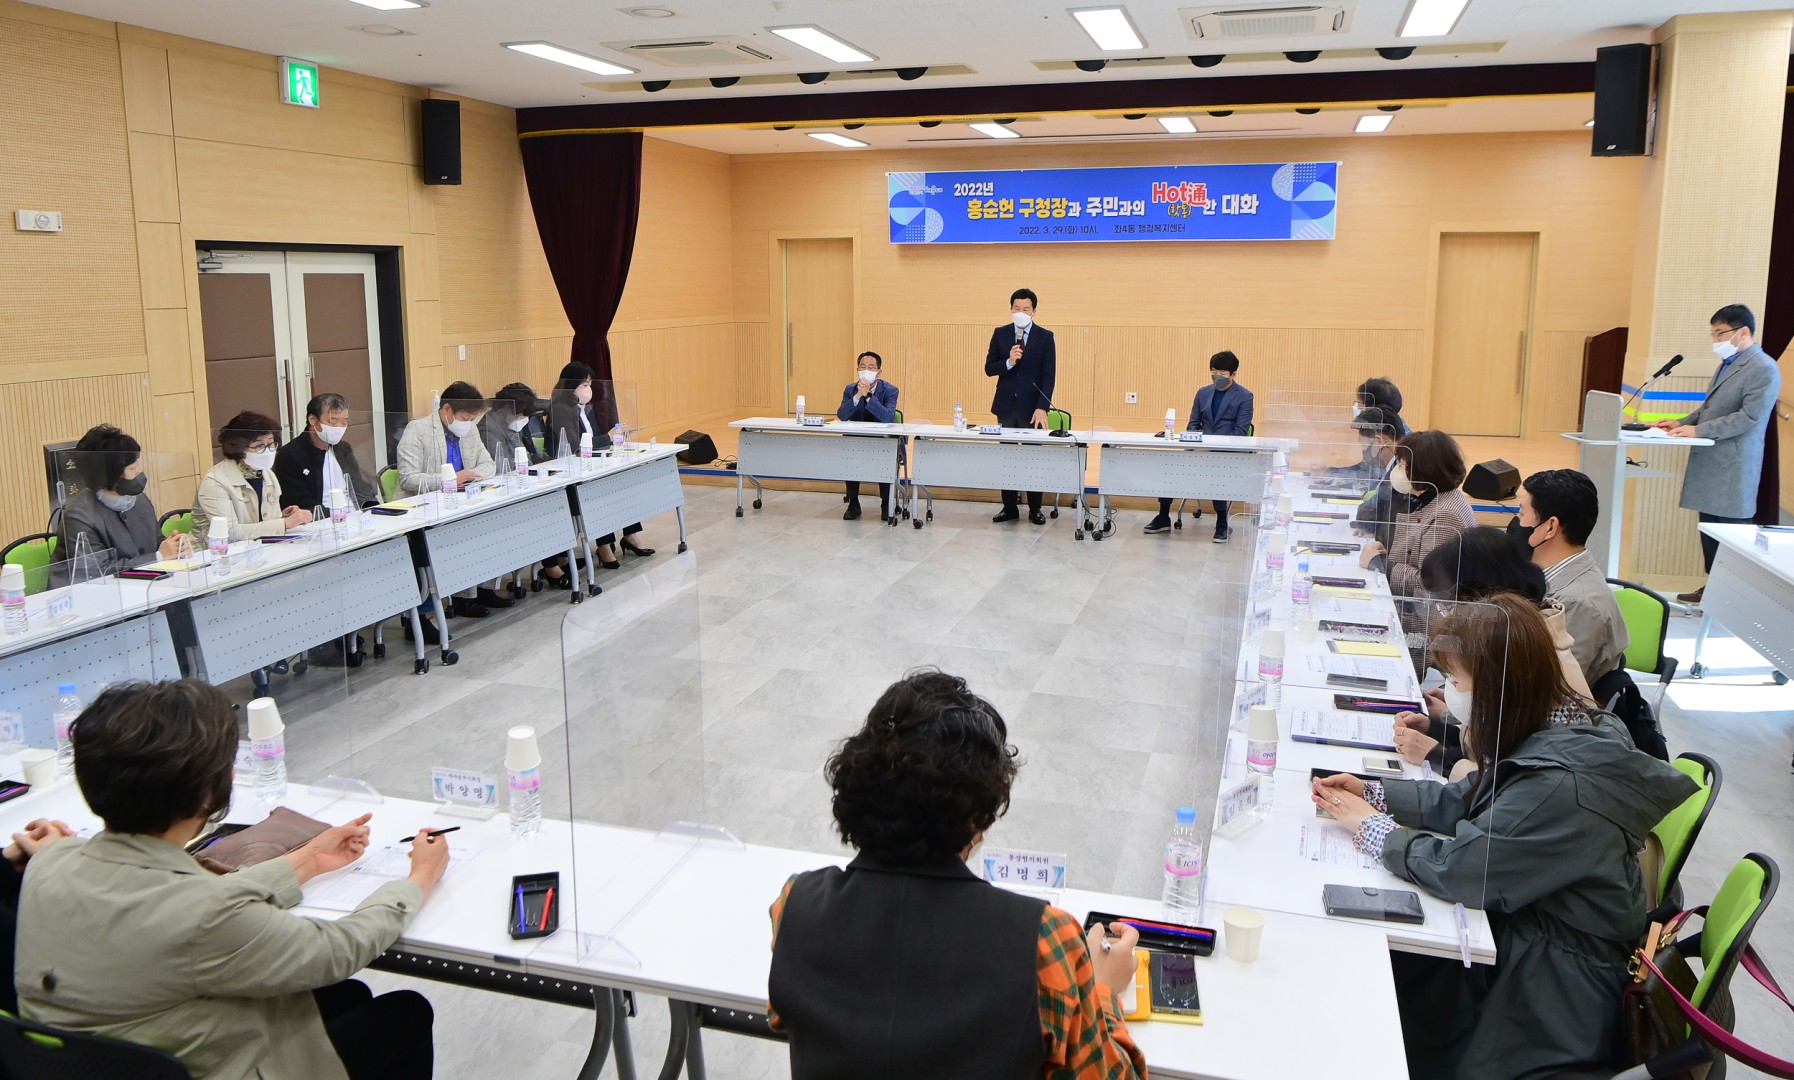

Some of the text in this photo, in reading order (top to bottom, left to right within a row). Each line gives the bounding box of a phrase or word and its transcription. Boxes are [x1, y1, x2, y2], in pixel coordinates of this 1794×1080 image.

[954, 182, 994, 197] 2022년
[967, 198, 1015, 220] 홍순헌
[1018, 197, 1081, 219] 구청장과
[1085, 196, 1146, 217] 주민과의
[1221, 194, 1260, 215] 대화
[1019, 226, 1040, 235] 2022.
[1138, 224, 1186, 233] 행정복지센터
